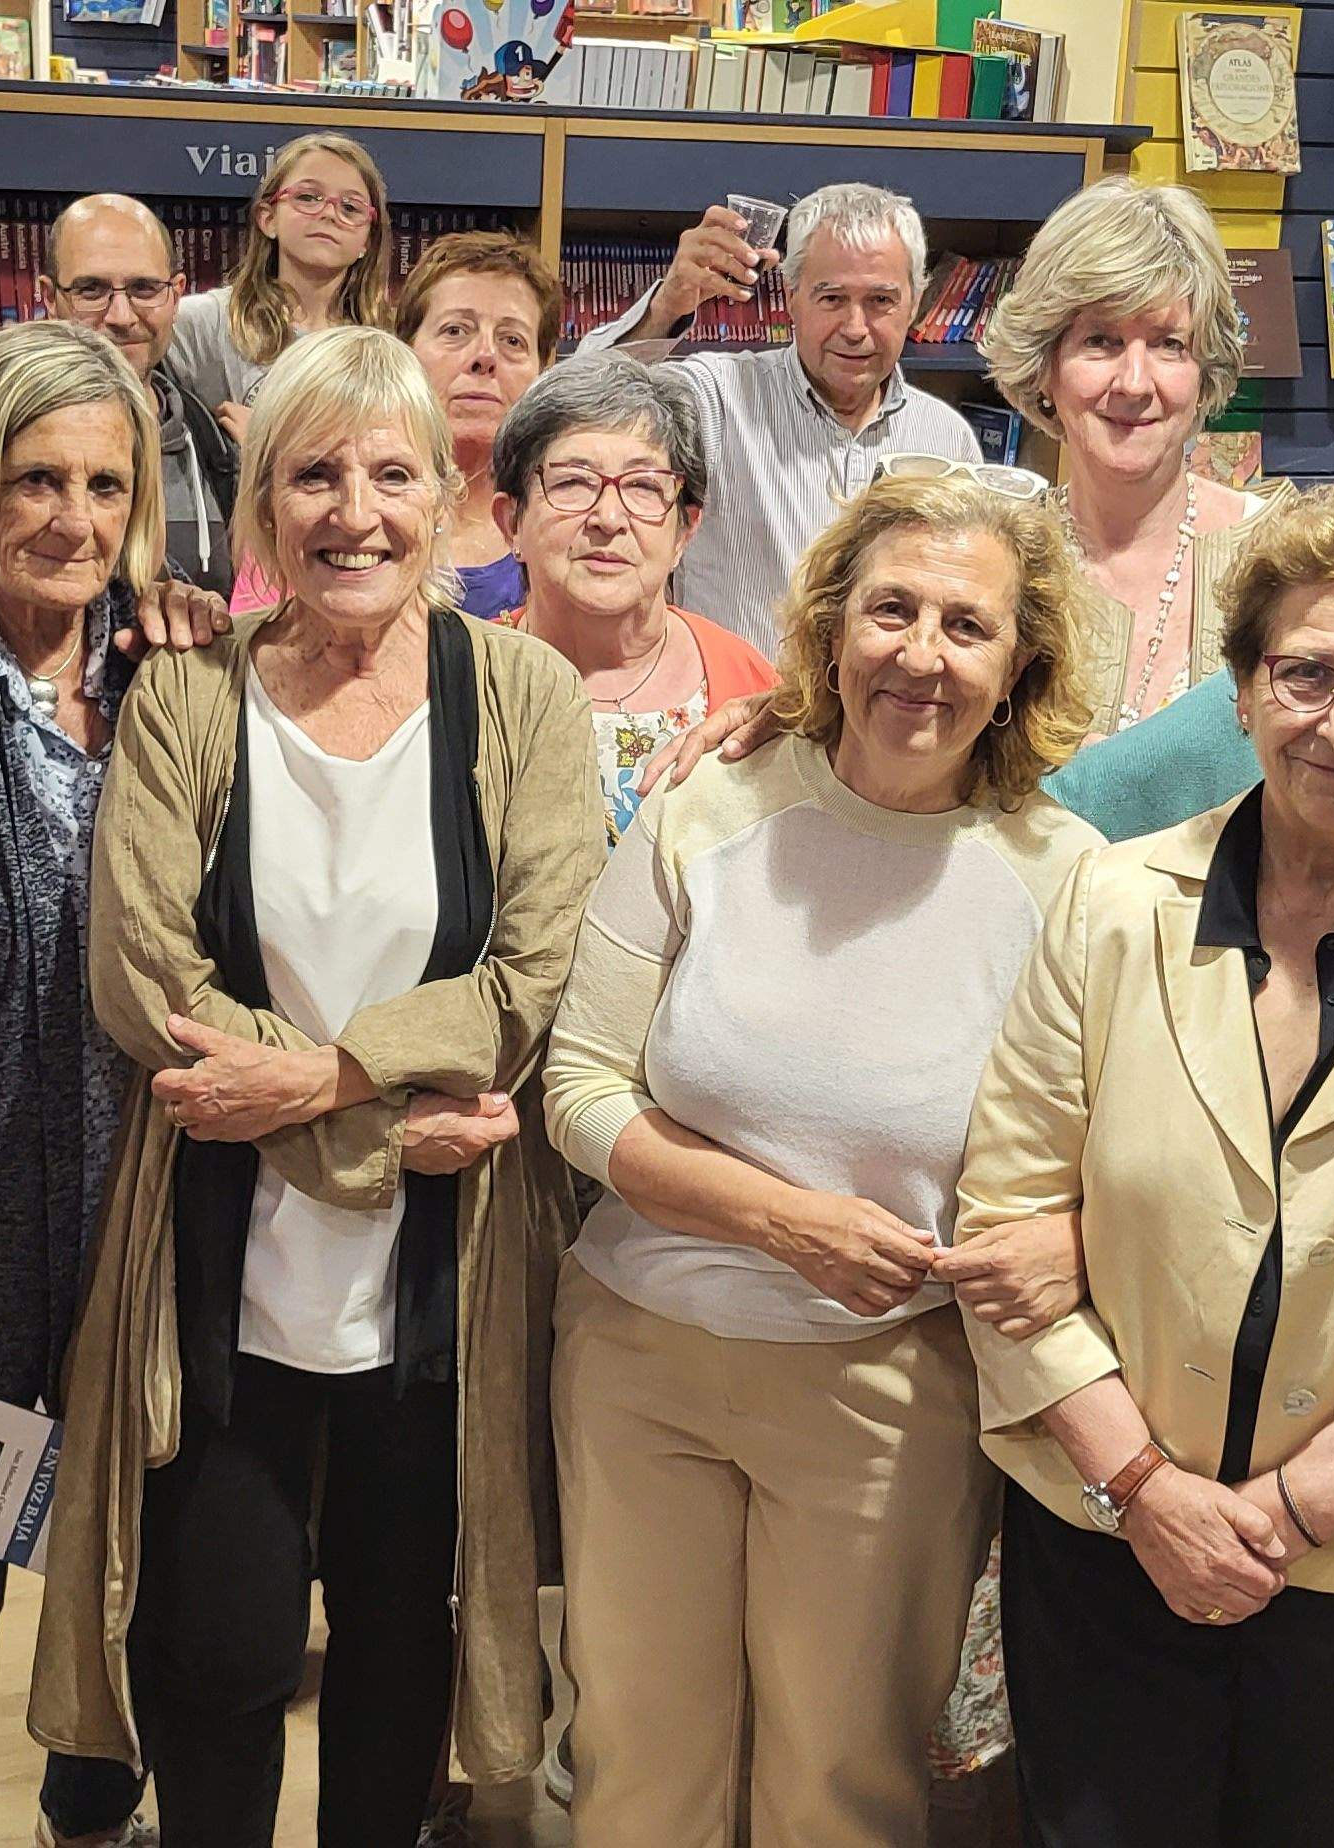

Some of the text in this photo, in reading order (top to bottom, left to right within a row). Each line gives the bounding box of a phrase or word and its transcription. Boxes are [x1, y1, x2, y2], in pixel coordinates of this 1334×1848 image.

[185, 144, 276, 182] Viaj
[399, 236, 412, 275] Irlanda
[15, 1447, 60, 1541] EN VOZ BAJA
